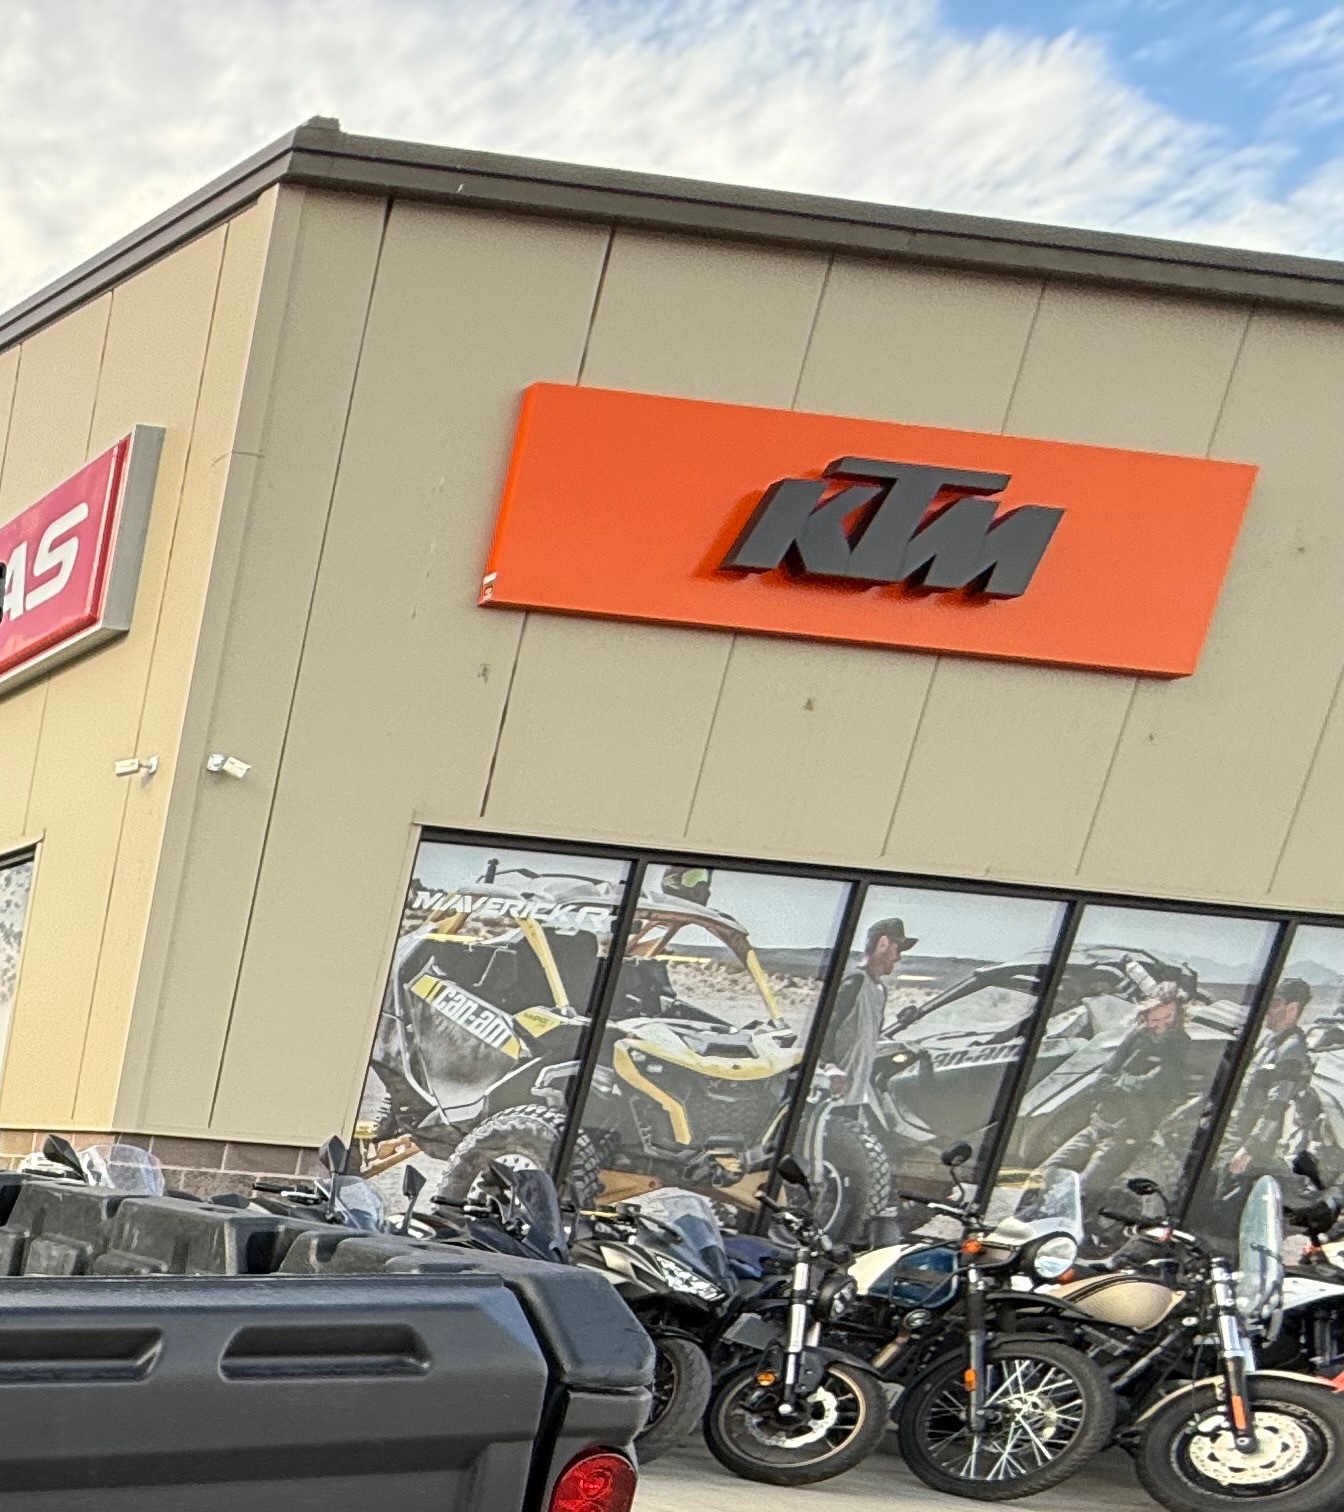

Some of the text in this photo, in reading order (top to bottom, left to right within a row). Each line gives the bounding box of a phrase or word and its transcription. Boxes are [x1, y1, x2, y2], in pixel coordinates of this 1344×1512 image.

[718, 457, 1065, 600] KTM
[413, 891, 577, 924] MAVERICK
[933, 1043, 1020, 1068] an-am
